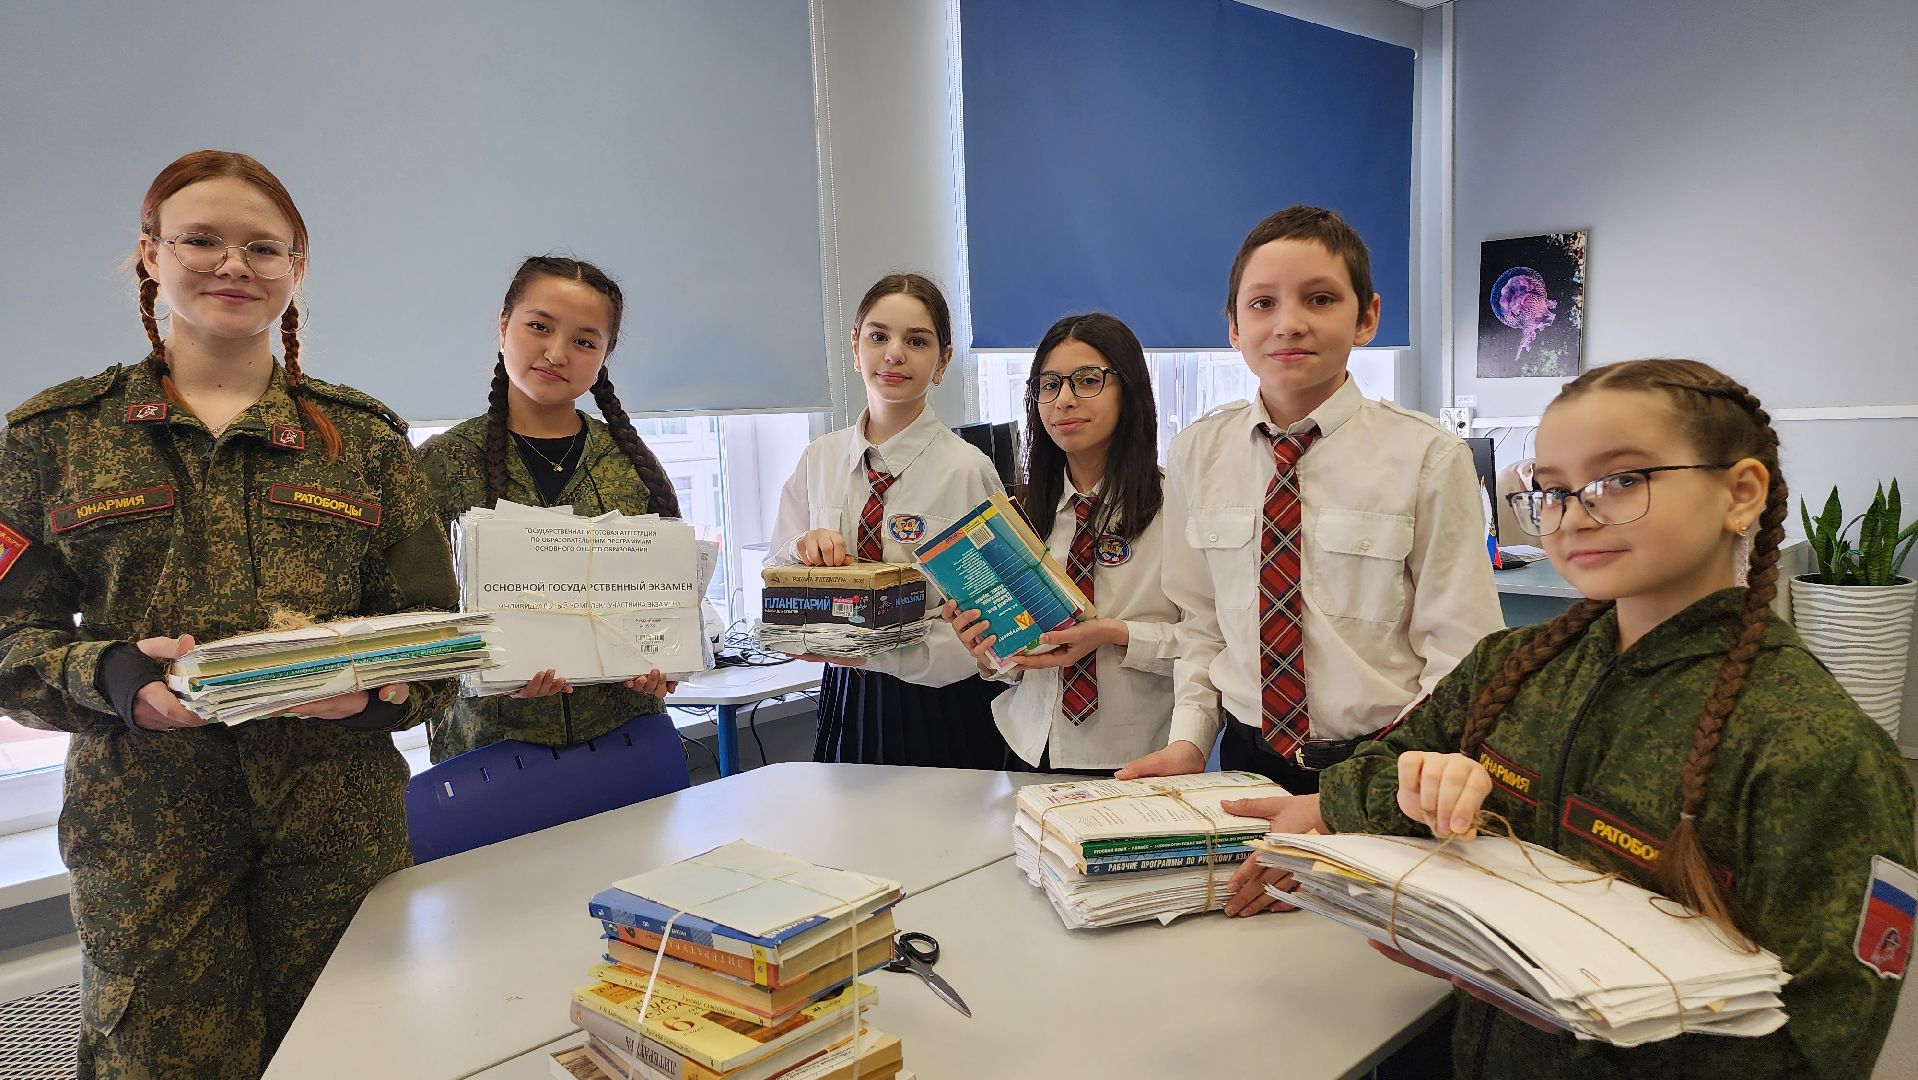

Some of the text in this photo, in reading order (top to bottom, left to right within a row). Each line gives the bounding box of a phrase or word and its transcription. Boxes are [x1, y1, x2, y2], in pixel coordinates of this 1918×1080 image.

[76, 494, 145, 518] ЮНАРМИЯ
[293, 491, 363, 517] РАТОБОРЦЫ
[484, 580, 693, 593] ОСНОВНОЙ ГОСУДАРСТВЕННЫЙ ЭКЗАМЕН
[764, 595, 831, 611] ПЛАНЕТАРИЙ
[1107, 861, 1138, 872] РАБОЧИЕ
[1140, 857, 1184, 869] ПРОГРАММЫ
[1186, 856, 1196, 865] ПО
[1235, 852, 1250, 861] ЯЗЫ
